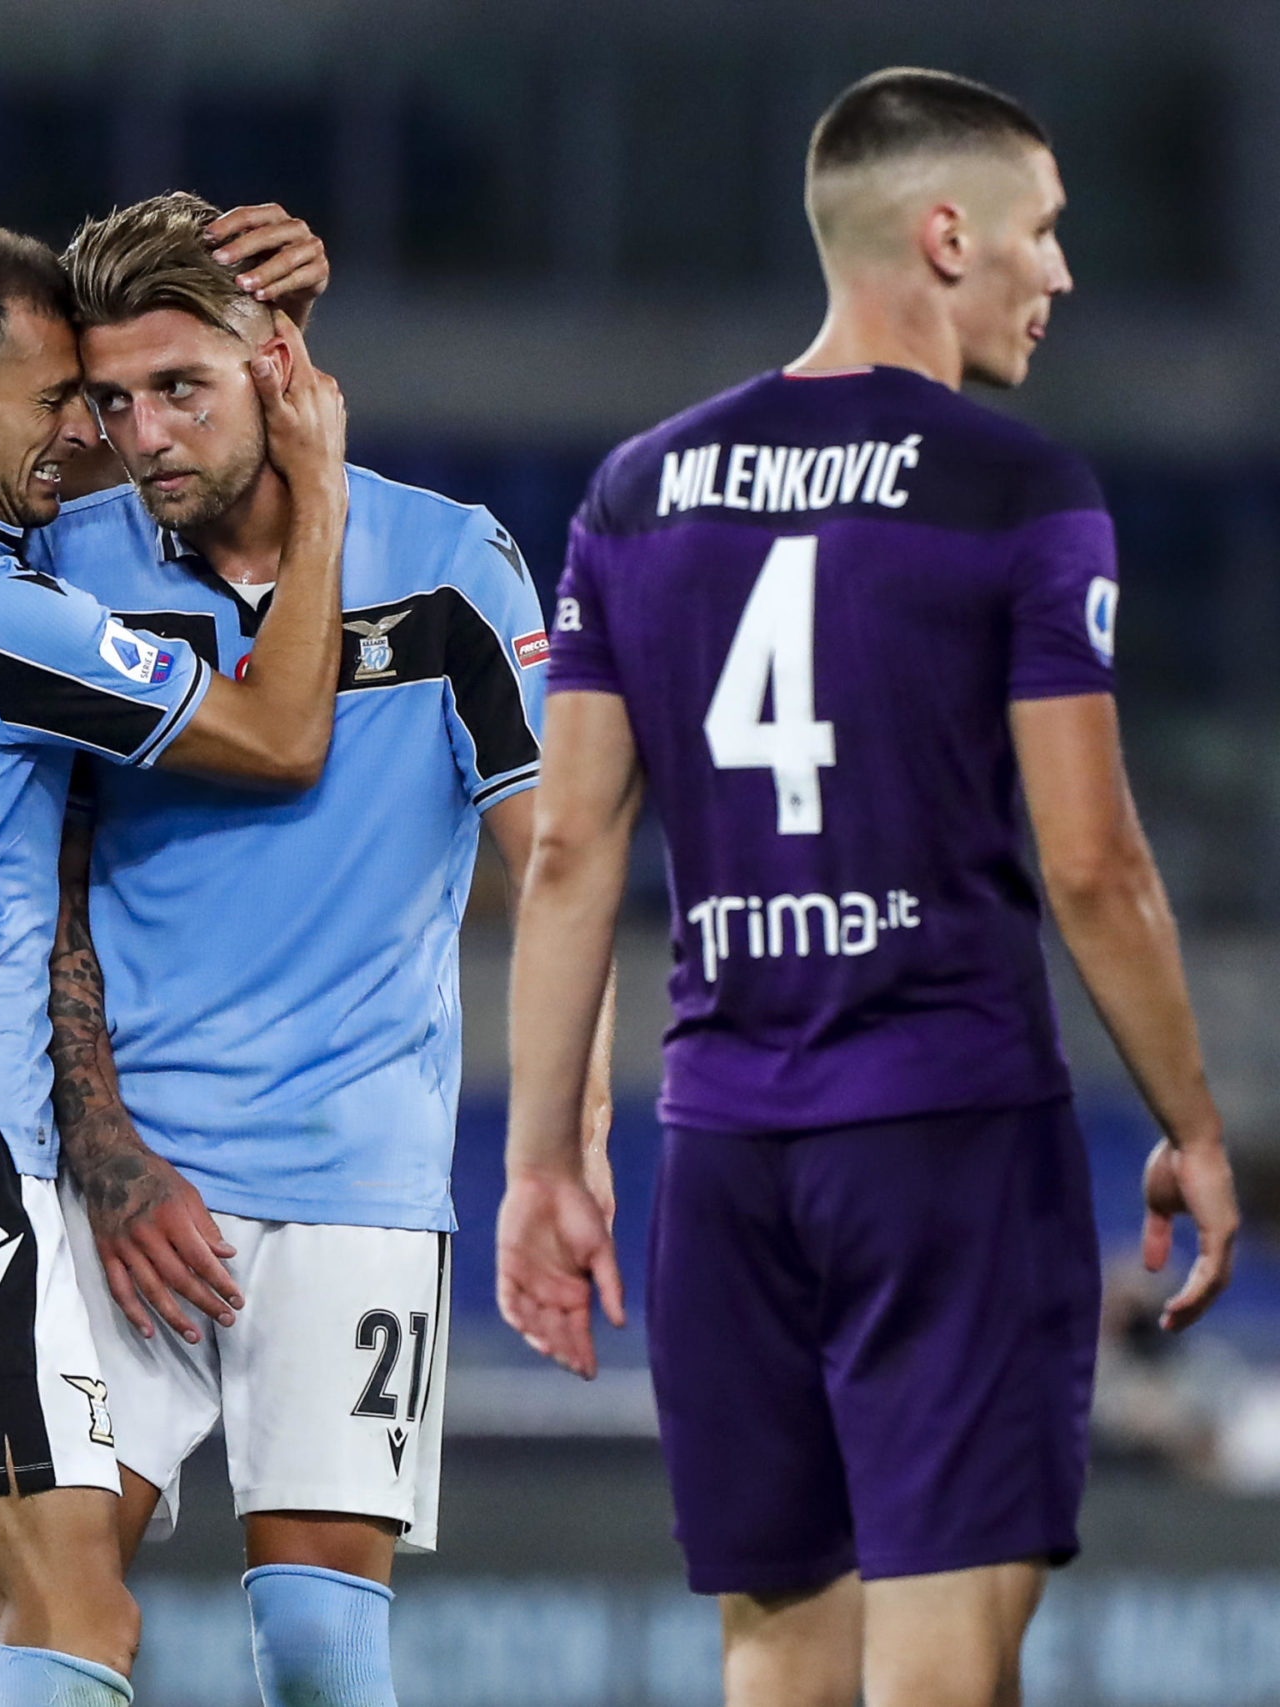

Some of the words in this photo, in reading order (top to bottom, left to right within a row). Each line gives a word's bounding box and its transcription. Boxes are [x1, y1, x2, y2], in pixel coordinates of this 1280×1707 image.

[656, 433, 923, 517] MILENKOVIĆ
[703, 534, 837, 835] 4
[350, 1308, 429, 1422] 21
